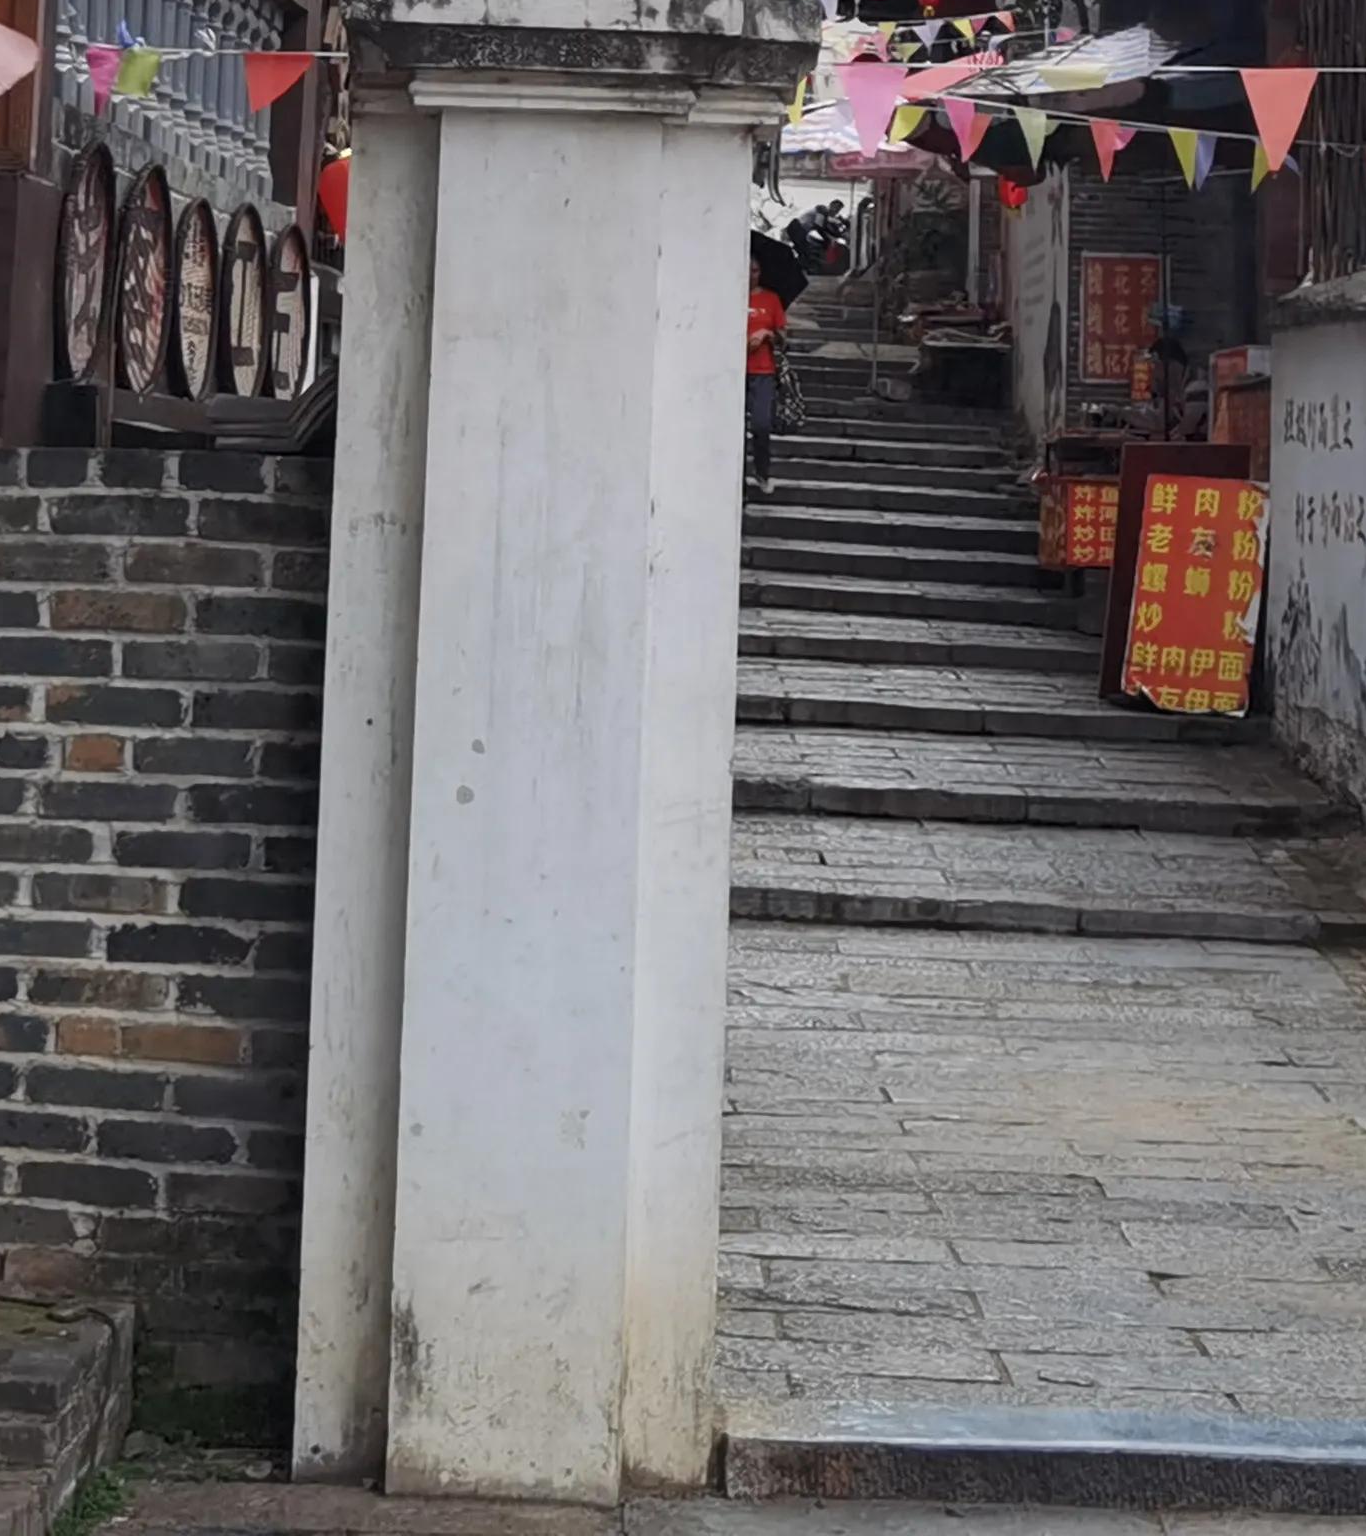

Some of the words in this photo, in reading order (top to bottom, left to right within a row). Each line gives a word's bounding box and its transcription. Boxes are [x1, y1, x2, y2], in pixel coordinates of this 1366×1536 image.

[1150, 482, 1264, 520] 鲜肉粉
[1146, 523, 1257, 561] 老友粉
[1129, 641, 1245, 682] 鲜肉伊面
